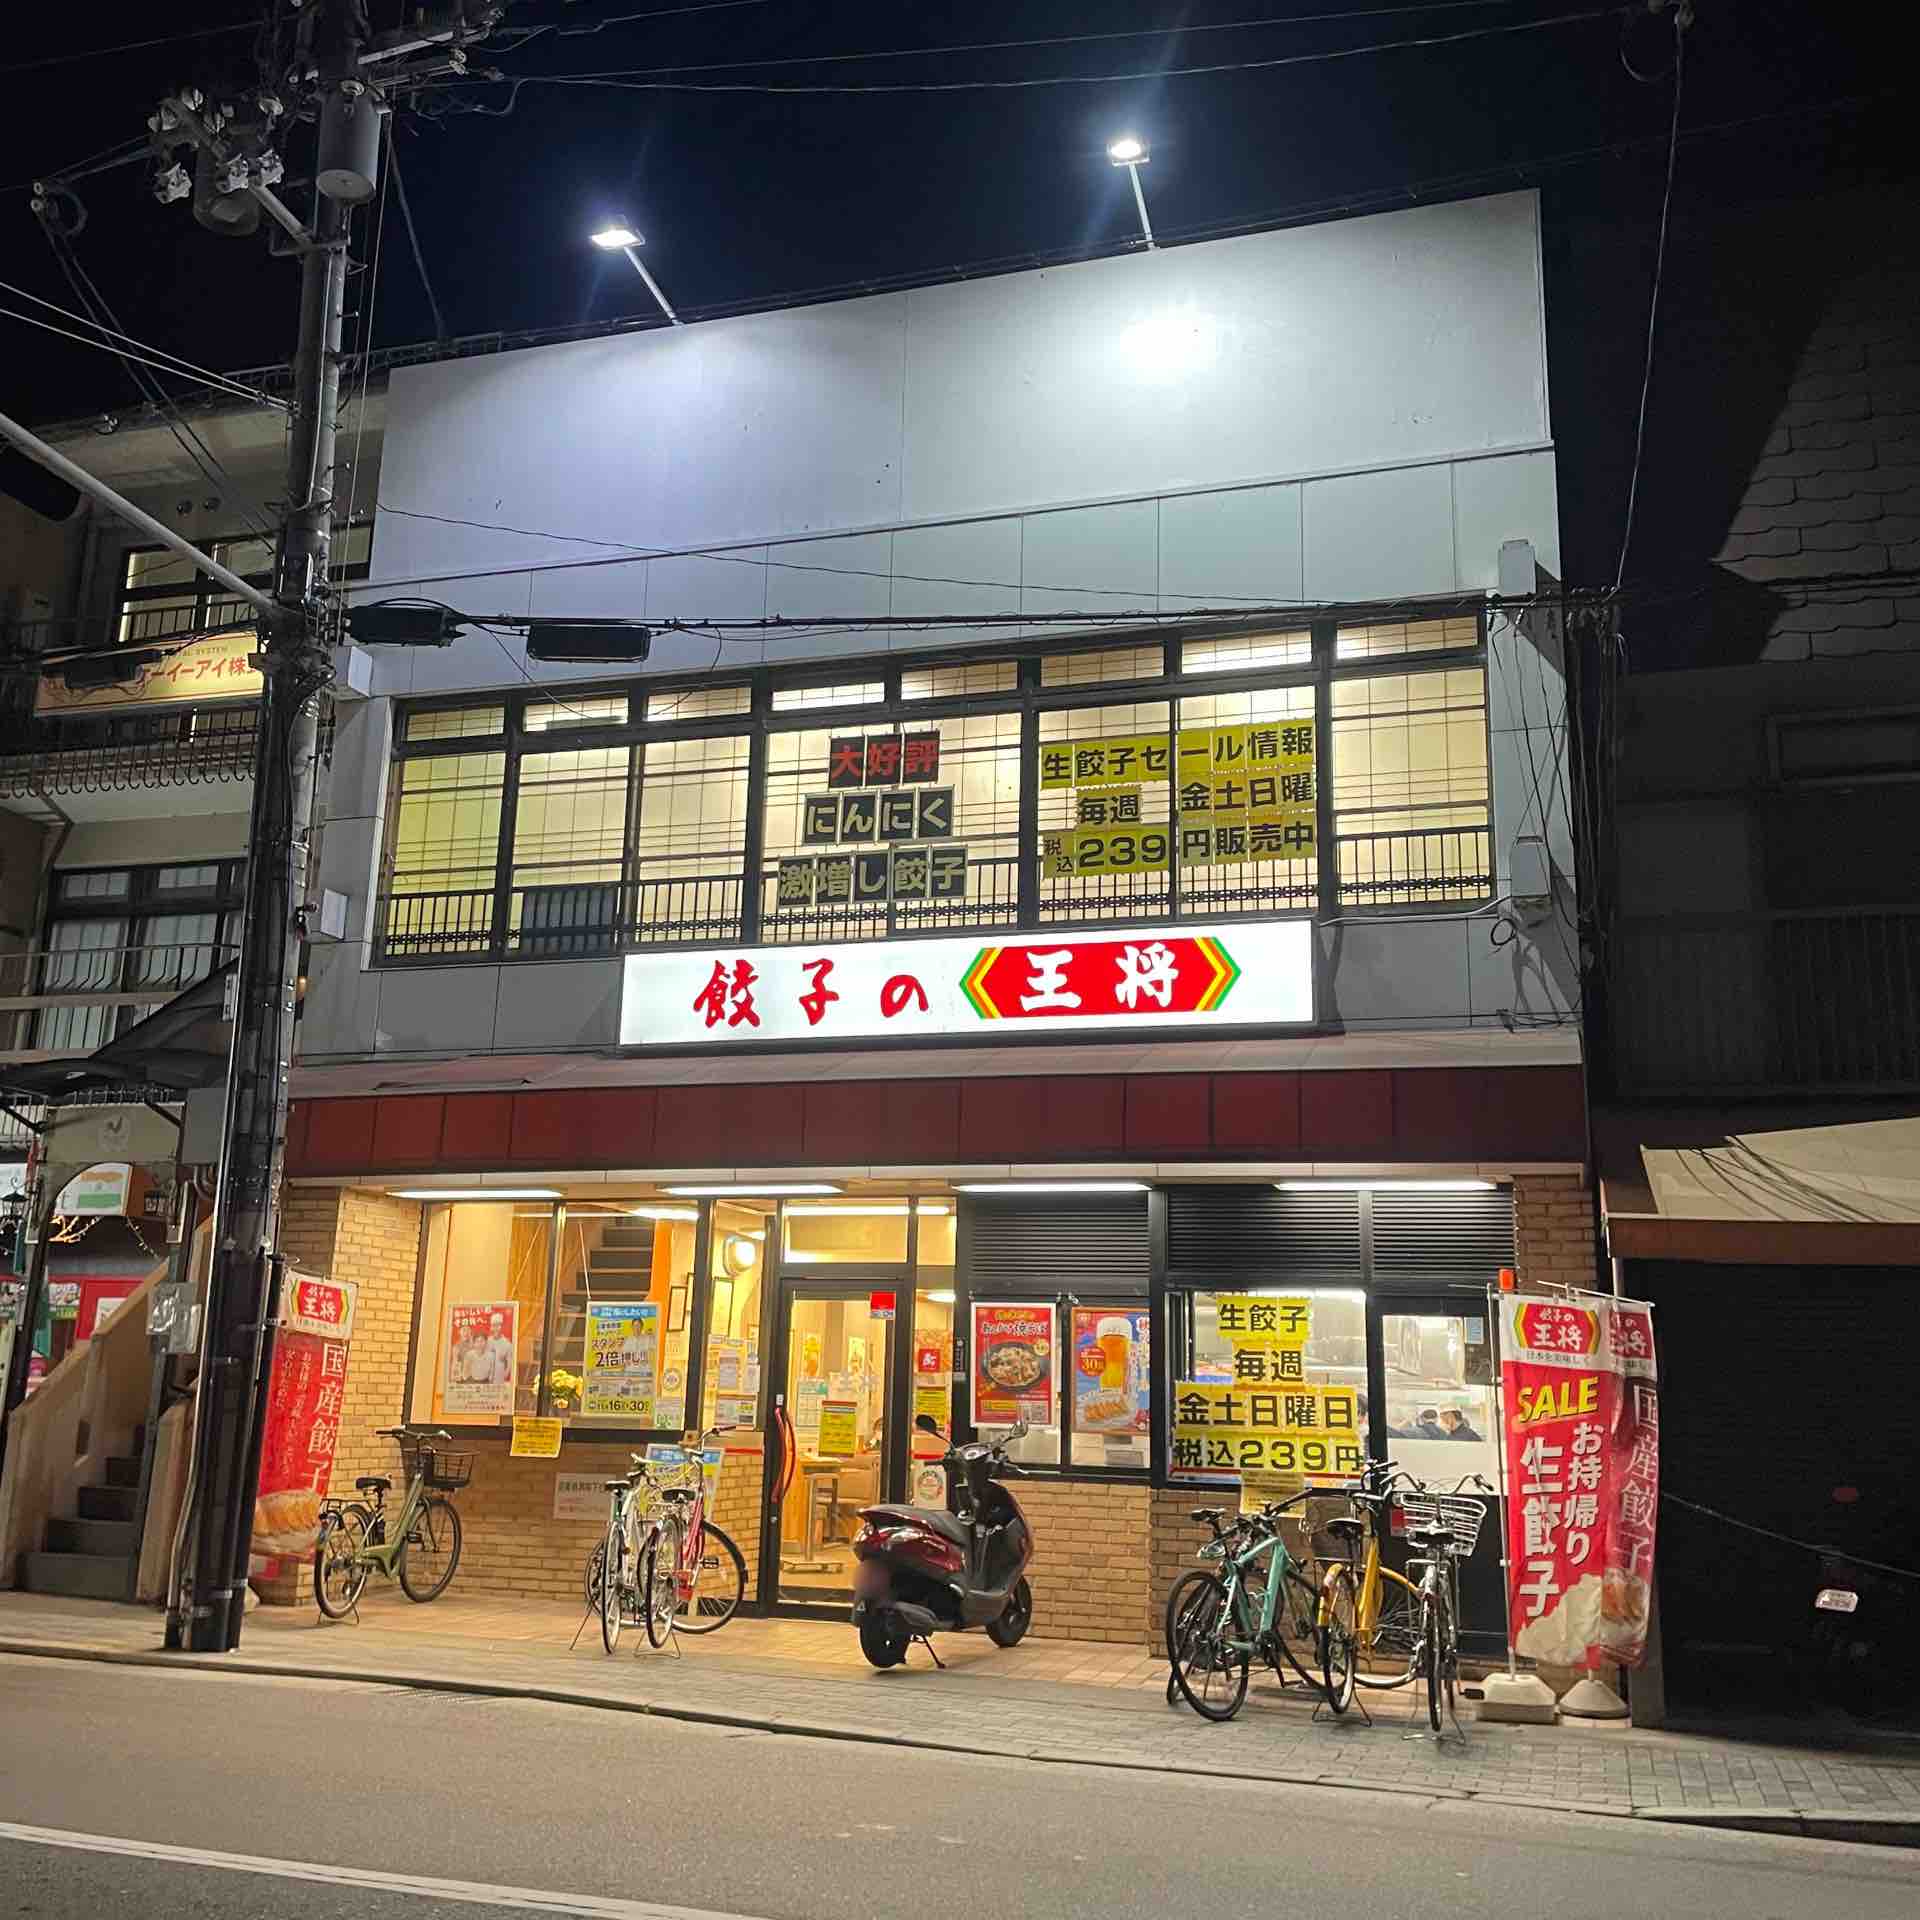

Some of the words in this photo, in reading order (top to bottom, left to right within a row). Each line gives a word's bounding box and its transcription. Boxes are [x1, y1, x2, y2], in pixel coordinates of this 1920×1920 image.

[831, 740, 938, 779] 大好評
[807, 798, 947, 836] にんにく
[1077, 795, 1141, 825] 毎週
[1181, 772, 1313, 812] 金土日曜
[779, 857, 965, 898] 激増し餃子
[303, 1298, 337, 1321] 王将
[1219, 1304, 1307, 1332] 生餃子
[1533, 1322, 1583, 1351] 王将
[1234, 1349, 1304, 1382] 毎週
[301, 1343, 347, 1490] 国産餃子
[1178, 1392, 1353, 1428] 金土日曜日
[1516, 1376, 1599, 1422] SALE
[1175, 1438, 1361, 1471] 税込239円
[1562, 1421, 1604, 1566] お持帰り
